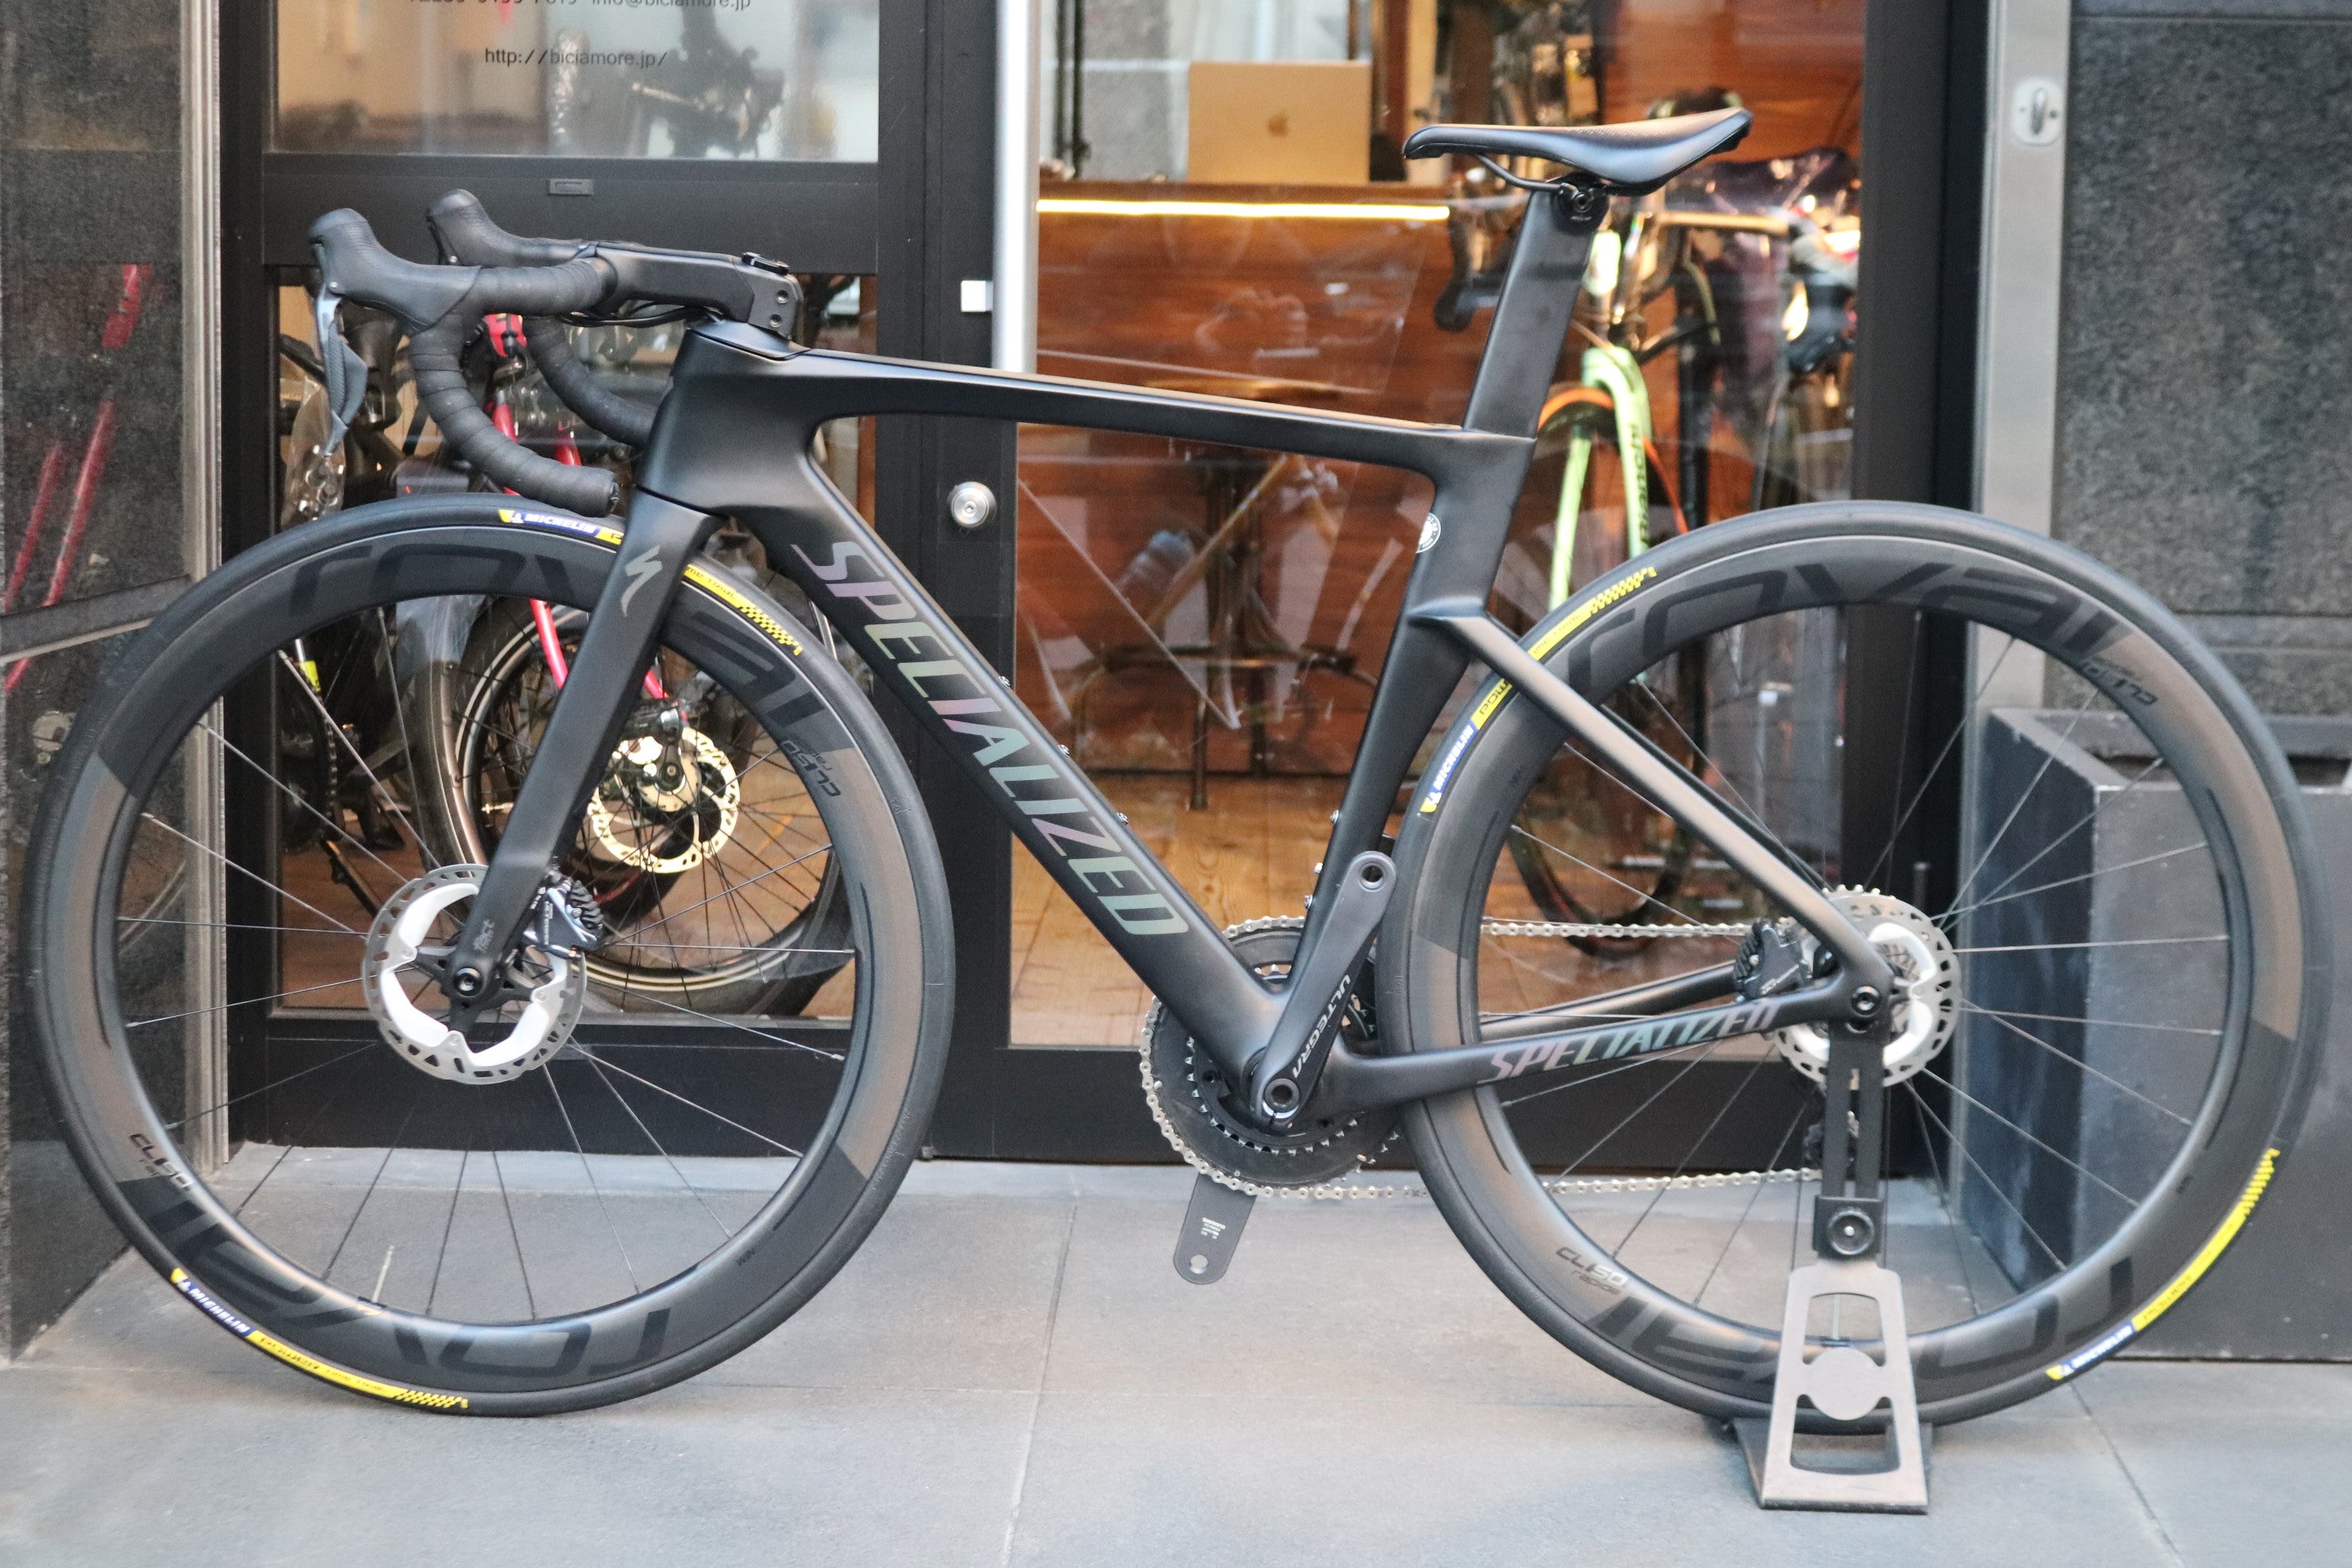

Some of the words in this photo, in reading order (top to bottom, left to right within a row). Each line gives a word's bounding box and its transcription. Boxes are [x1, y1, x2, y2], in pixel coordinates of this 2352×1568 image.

[484, 48, 667, 69] http://biciamore.jp/
[525, 513, 597, 535] MICHELIN
[1479, 680, 1510, 714] POW
[790, 541, 1189, 936] SPECIALIZED
[1434, 724, 1476, 790] MICHELIN
[1292, 974, 1351, 1079] ULTEGRA
[1491, 997, 1781, 1080] SPECIALIZED
[189, 1285, 251, 1335] MICHELIN
